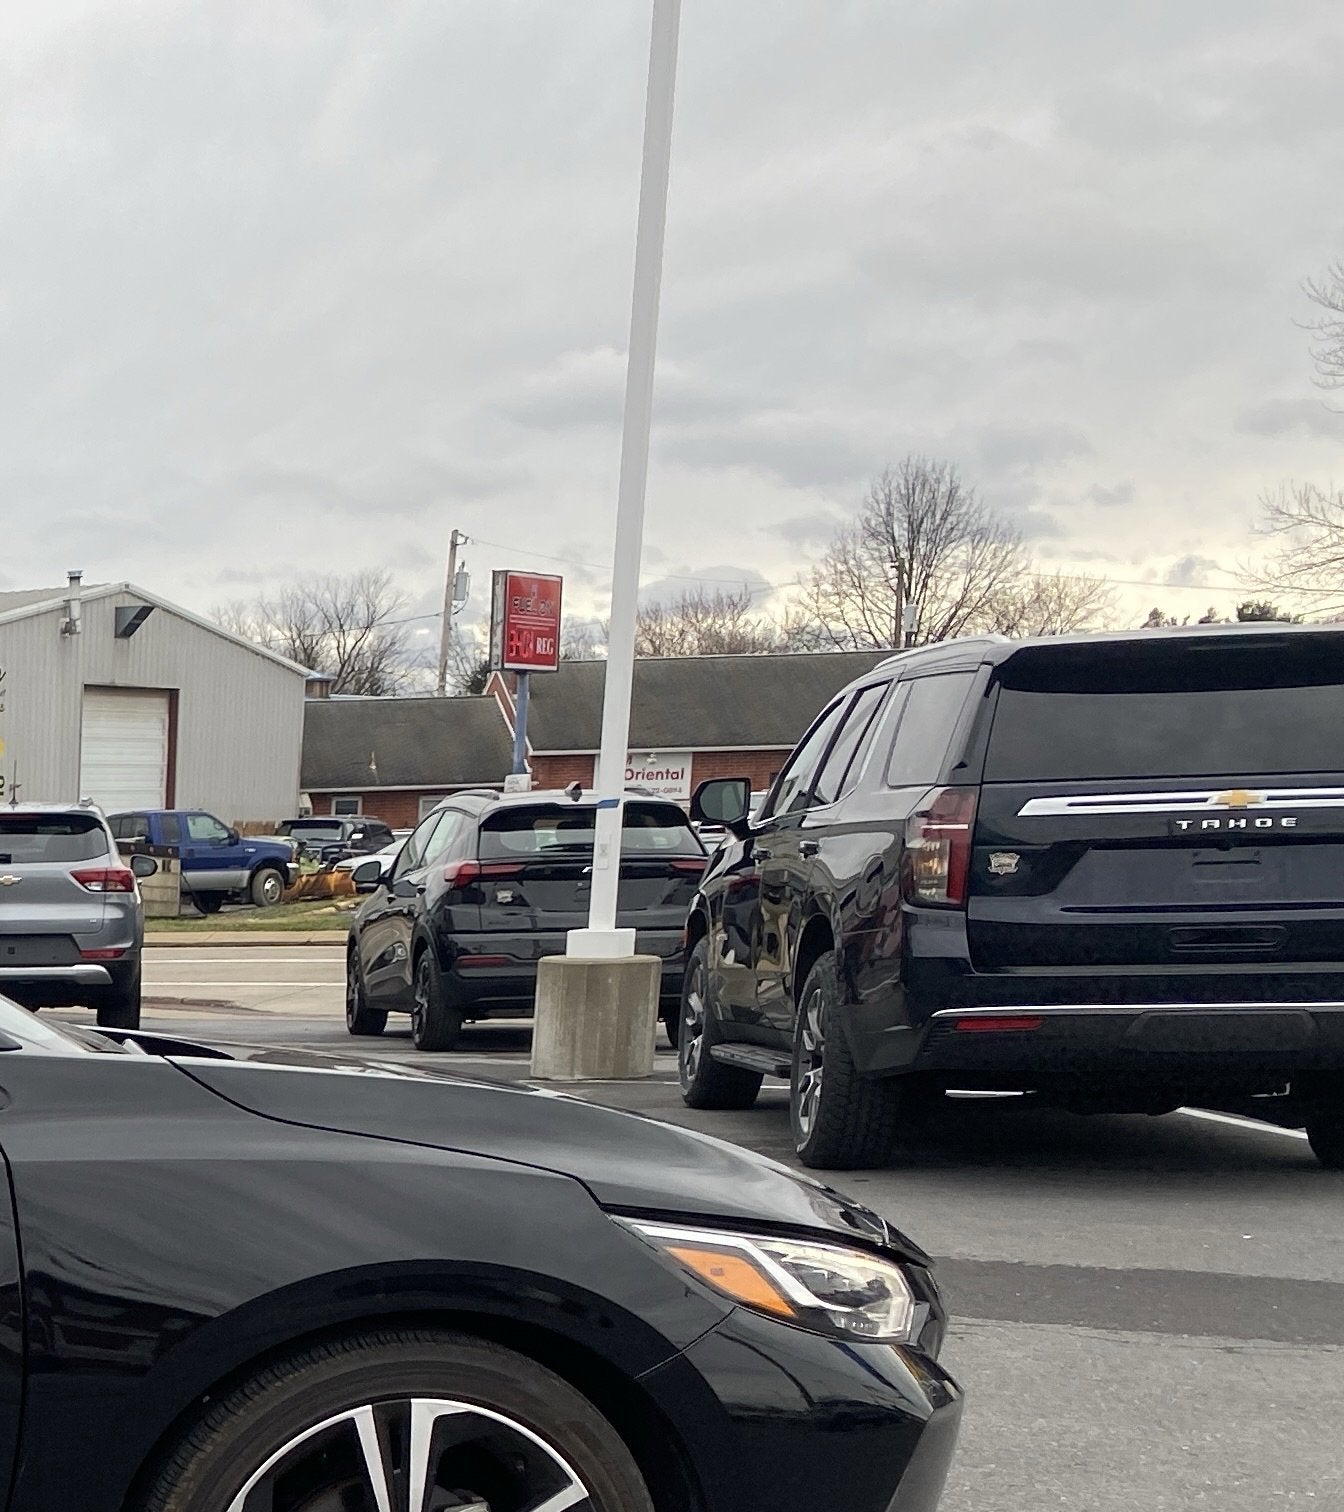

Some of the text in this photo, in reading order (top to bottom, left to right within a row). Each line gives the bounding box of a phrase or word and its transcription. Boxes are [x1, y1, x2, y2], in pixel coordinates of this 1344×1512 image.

[535, 637, 554, 655] REG
[625, 767, 685, 781] Oriental
[1176, 817, 1297, 830] TAHOE
